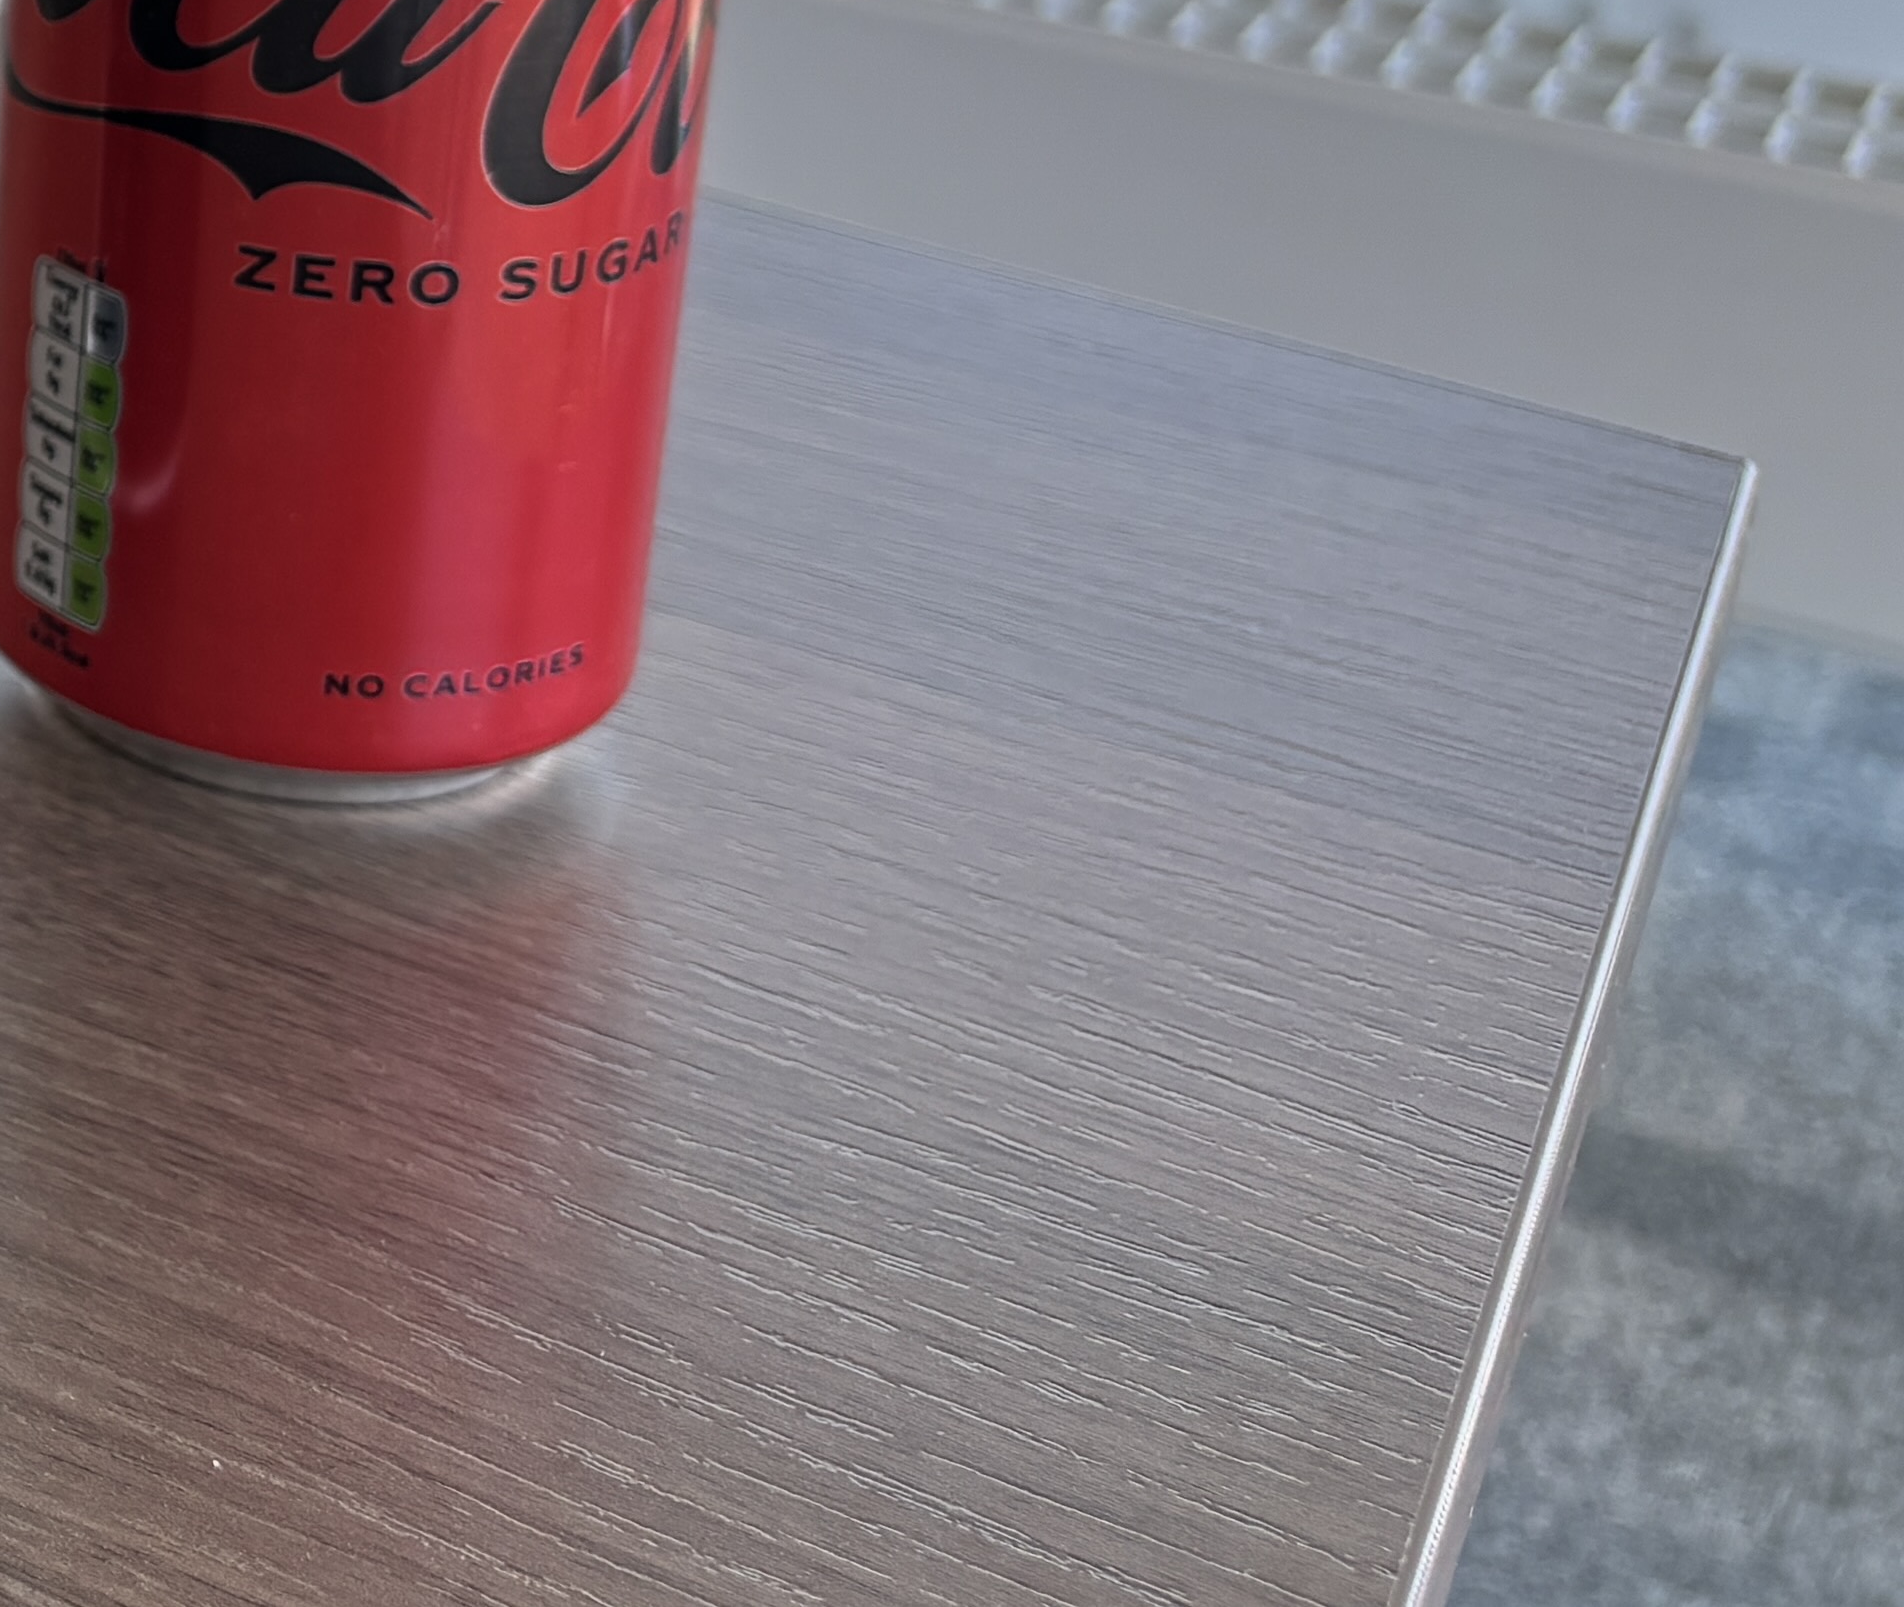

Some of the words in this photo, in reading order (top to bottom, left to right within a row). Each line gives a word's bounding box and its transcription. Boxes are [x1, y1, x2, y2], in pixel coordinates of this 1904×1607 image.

[233, 244, 460, 305] ZERO
[496, 210, 685, 301] SUGAR
[323, 672, 386, 698] NO
[402, 642, 585, 699] CALORIES
